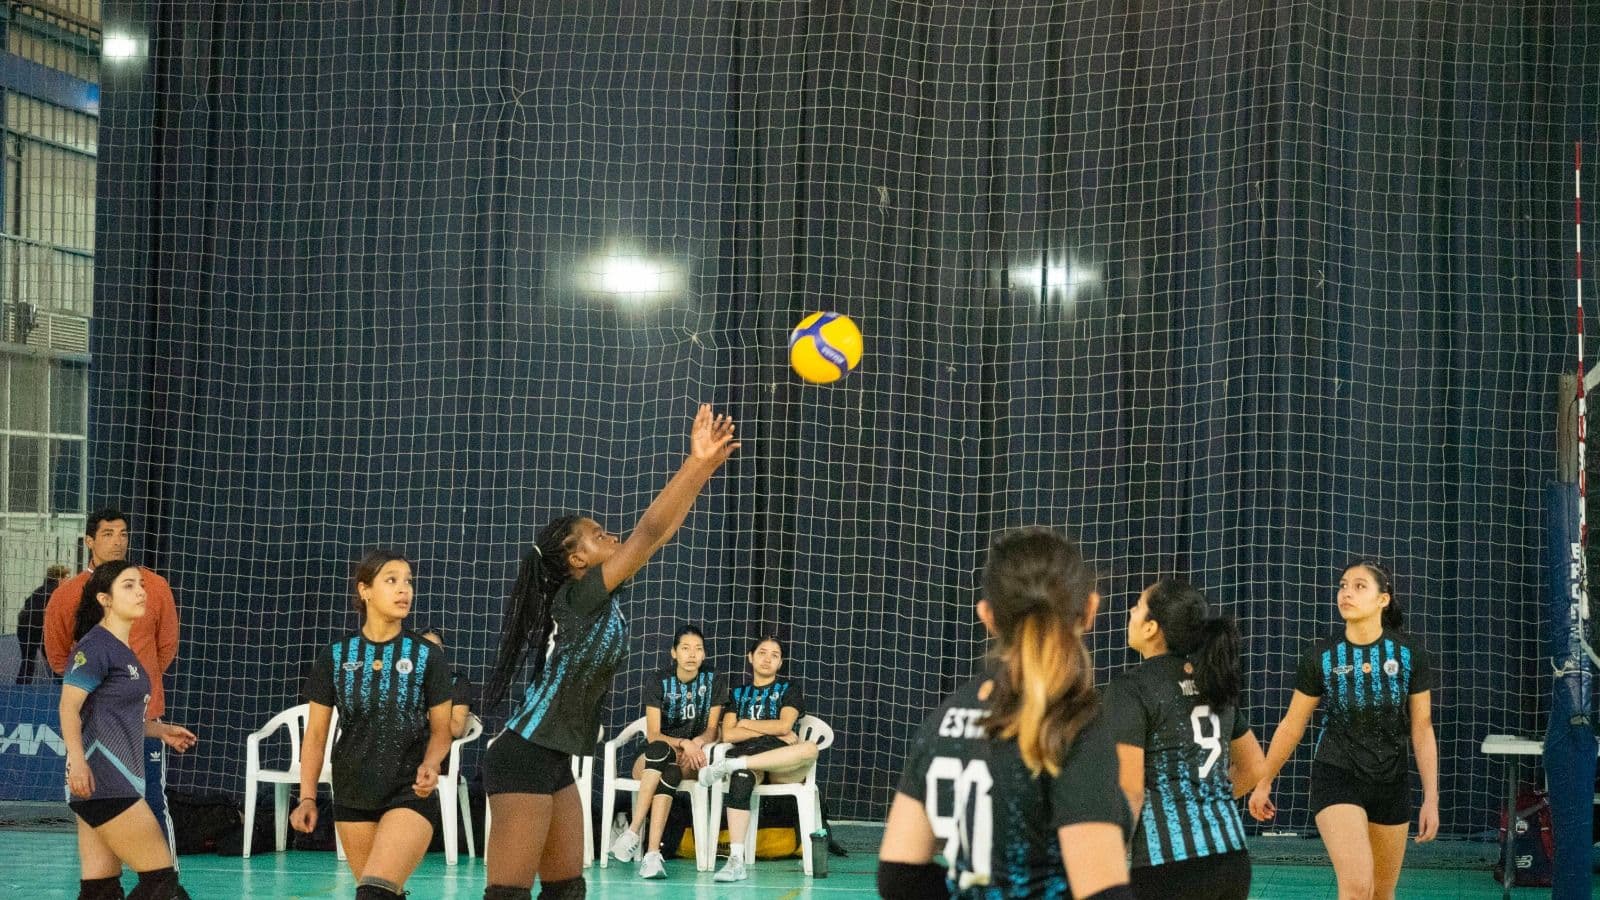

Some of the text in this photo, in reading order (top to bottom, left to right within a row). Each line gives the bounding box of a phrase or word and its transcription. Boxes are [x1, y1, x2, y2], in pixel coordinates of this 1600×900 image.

[681, 703, 696, 720] 10
[750, 704, 763, 720] 17
[1190, 705, 1222, 779] 9
